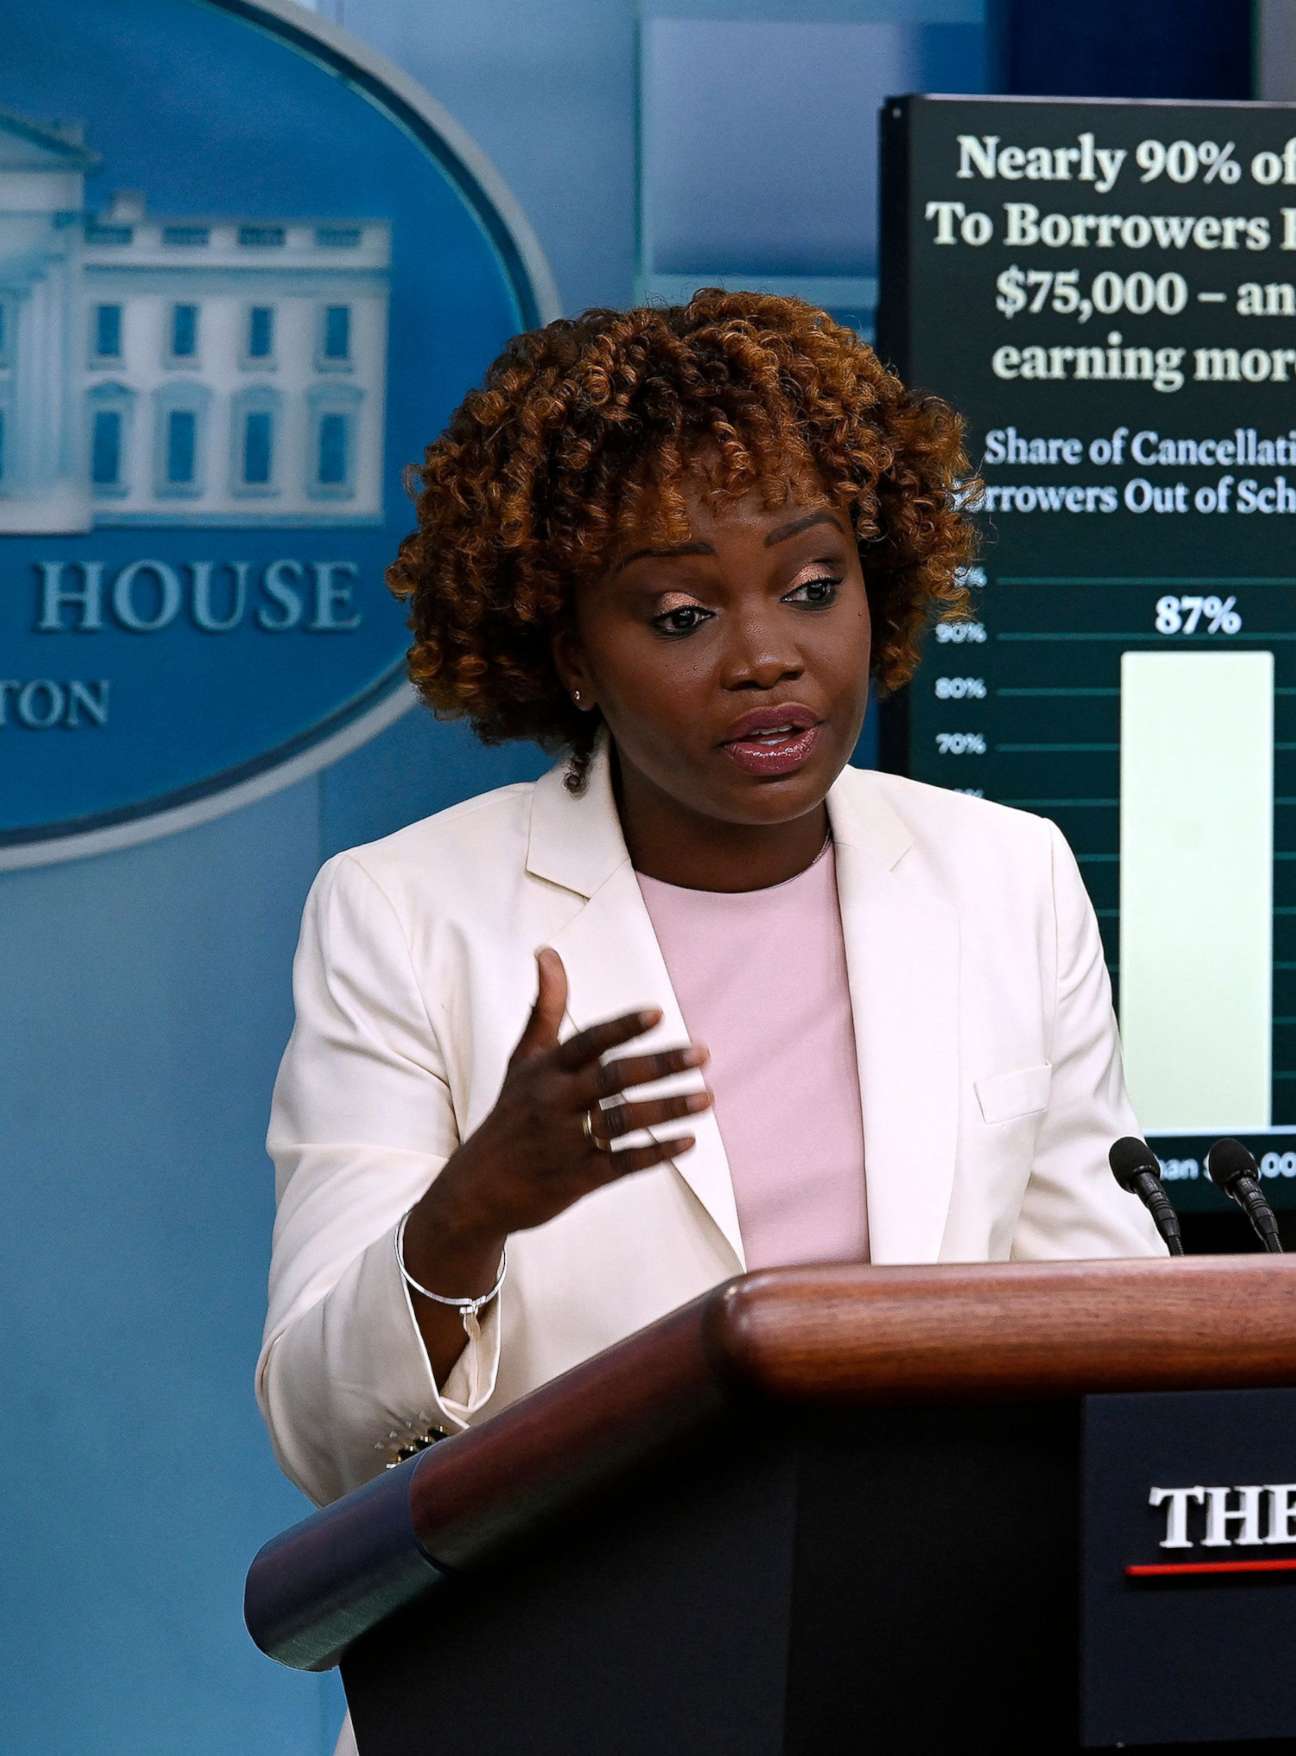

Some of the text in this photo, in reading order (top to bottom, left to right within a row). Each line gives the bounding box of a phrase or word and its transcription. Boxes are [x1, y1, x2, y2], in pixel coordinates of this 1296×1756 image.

[957, 133, 1126, 192] Nearly
[1136, 140, 1241, 184] 90%
[926, 202, 992, 245] To
[1005, 203, 1270, 250] Borrowers
[997, 266, 1187, 322] $75,000
[993, 332, 1185, 392] earning
[984, 427, 1087, 464] Share
[1089, 427, 1127, 464] of
[1125, 479, 1188, 513] Out
[1195, 476, 1235, 513] of
[36, 560, 360, 633] HOUSE
[1156, 596, 1241, 634] 87%
[936, 619, 986, 642] 90%
[936, 678, 986, 698] 80%
[936, 733, 986, 754] 70%
[1159, 1158, 1199, 1181] an
